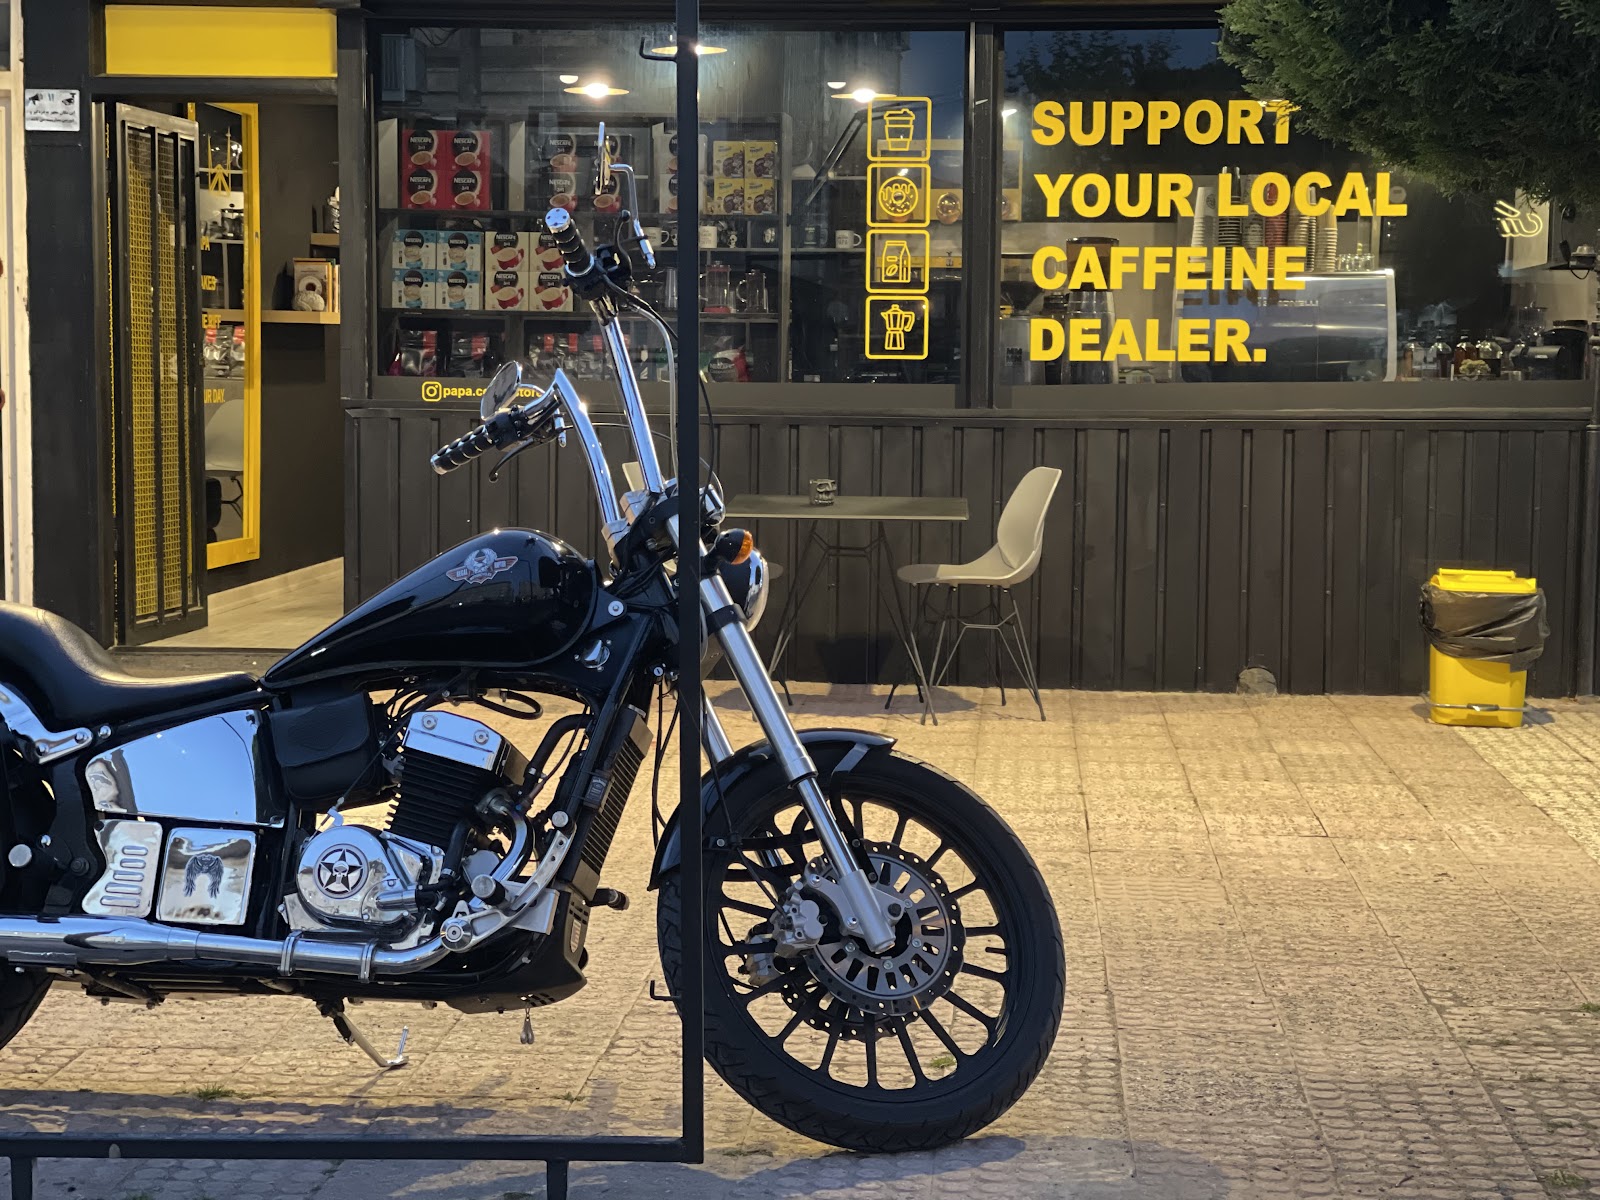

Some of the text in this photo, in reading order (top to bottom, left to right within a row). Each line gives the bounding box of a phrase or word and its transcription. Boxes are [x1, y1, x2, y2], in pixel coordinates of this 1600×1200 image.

[1032, 99, 1301, 146] SUPPORT
[1035, 172, 1407, 218] YOUR LOCAL
[1032, 246, 1306, 289] CAFFEINE
[1030, 319, 1266, 363] DEALER.
